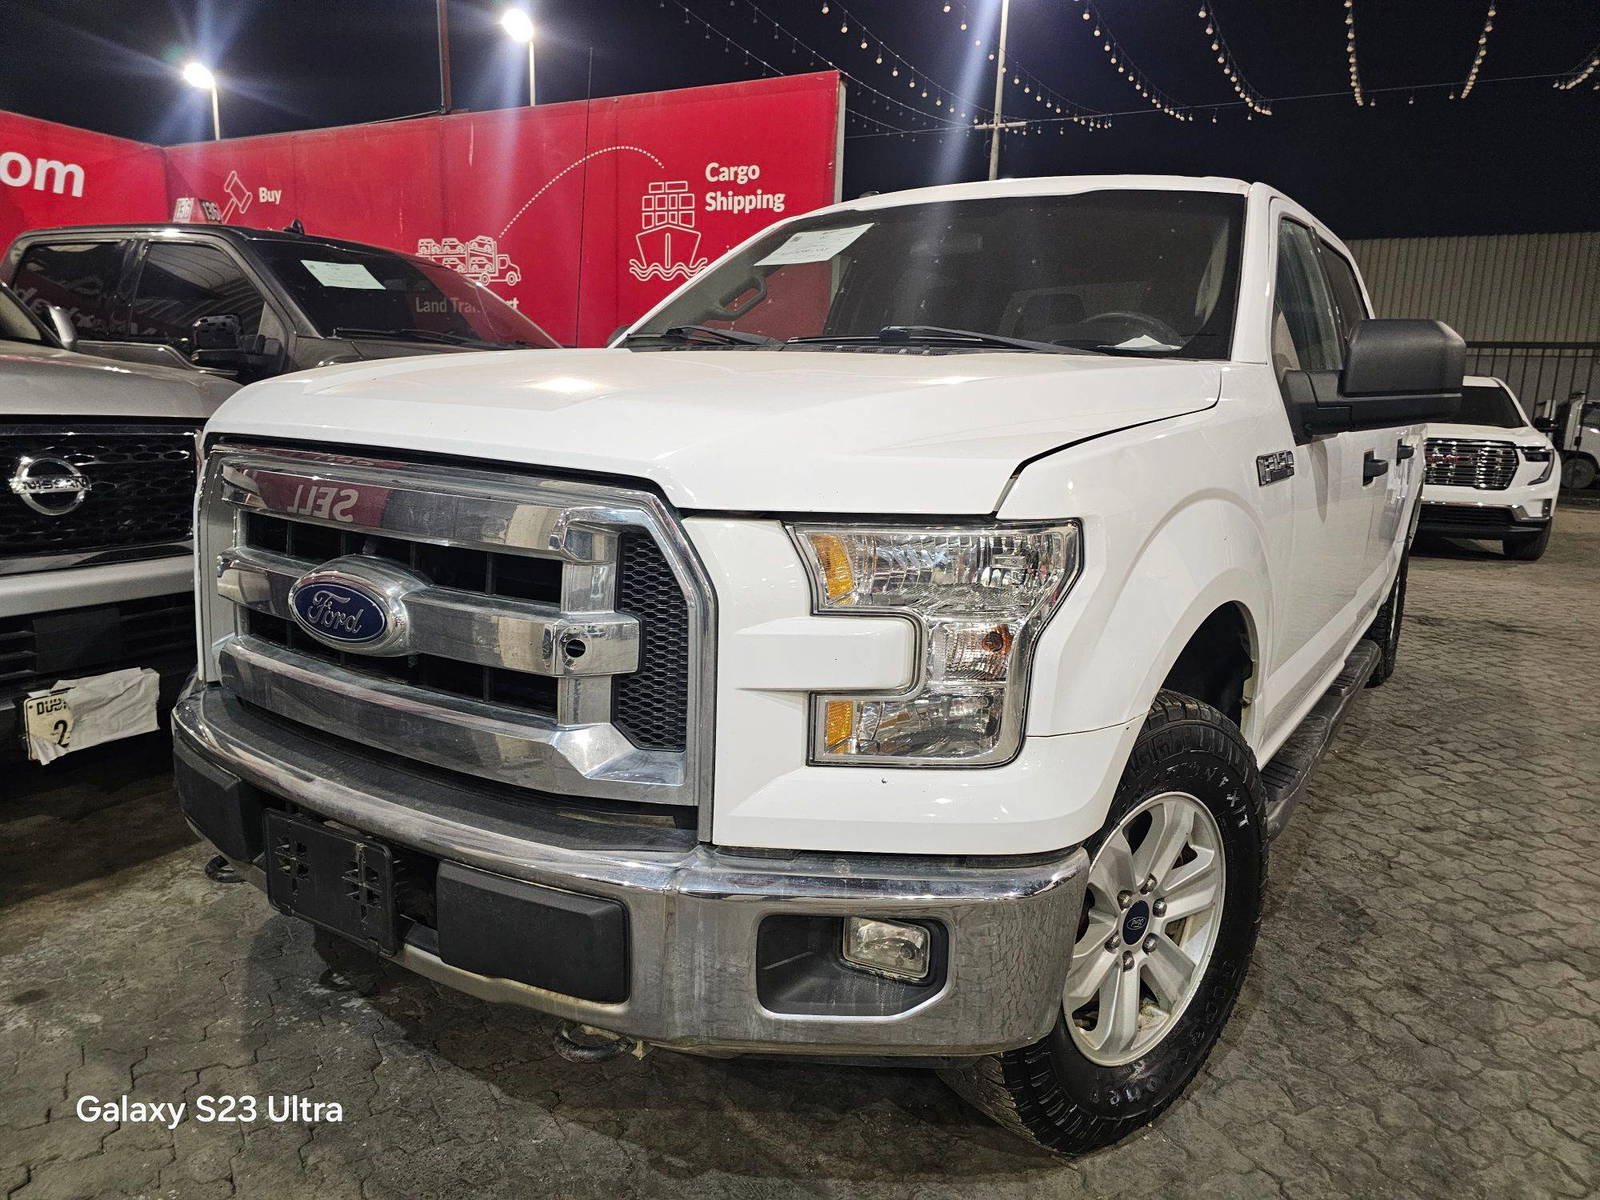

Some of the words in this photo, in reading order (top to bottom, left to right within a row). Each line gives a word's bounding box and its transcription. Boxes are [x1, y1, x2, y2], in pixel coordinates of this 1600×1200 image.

[705, 162, 761, 185] Cargo
[258, 187, 282, 205] Buy
[705, 189, 786, 214] Shipping
[415, 297, 447, 313] Land
[307, 590, 364, 634] Ford
